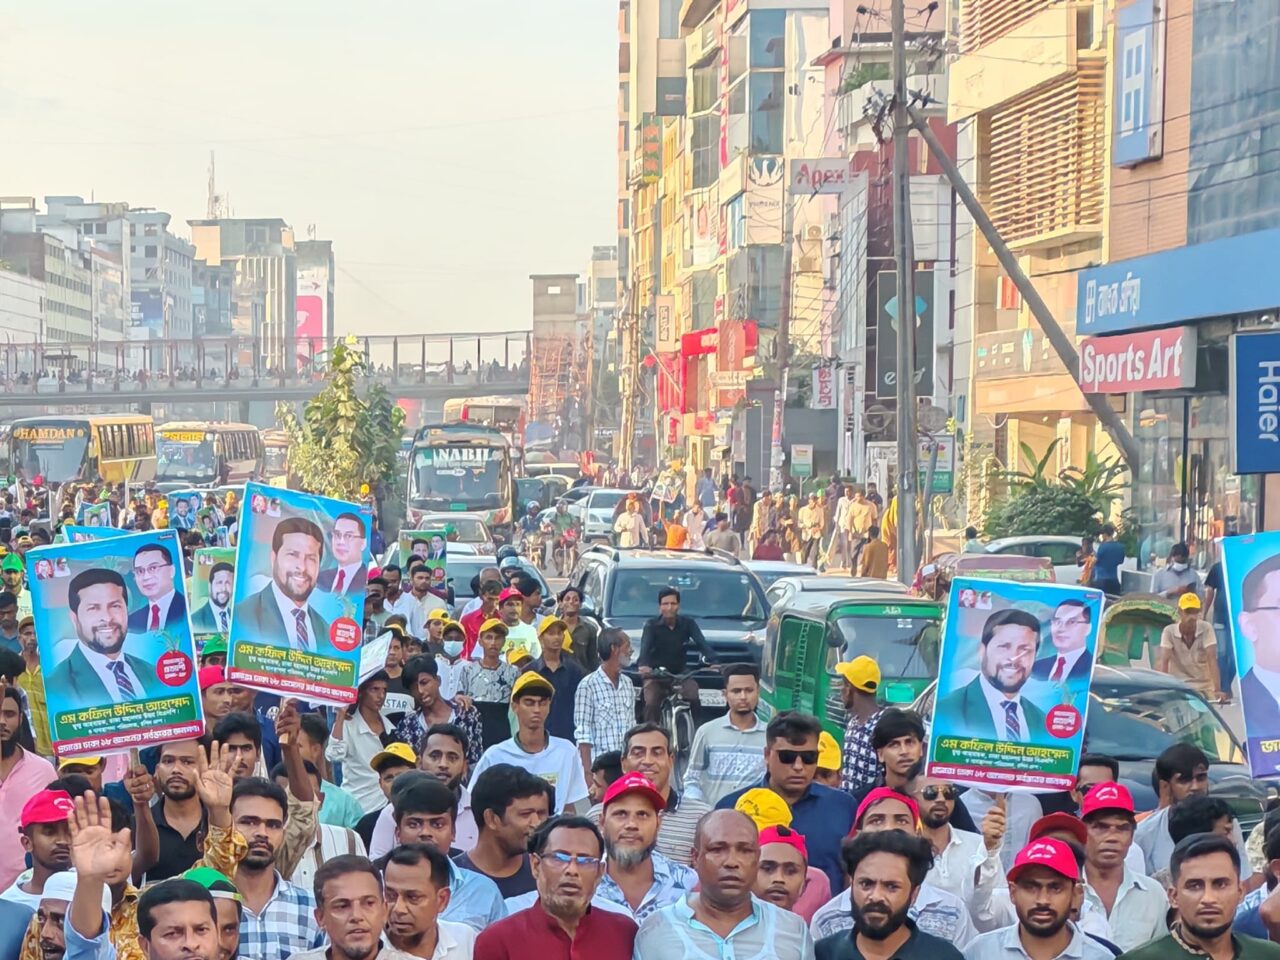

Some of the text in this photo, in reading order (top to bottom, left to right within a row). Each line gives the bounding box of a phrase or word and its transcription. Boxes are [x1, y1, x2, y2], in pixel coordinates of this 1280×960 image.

[1084, 335, 1183, 392] Sports Art
[1258, 361, 1280, 442] Haier
[255, 645, 286, 660] কফিল
[60, 714, 76, 725] এম
[79, 707, 112, 722] কফিল
[114, 702, 145, 717] উদ্দিন
